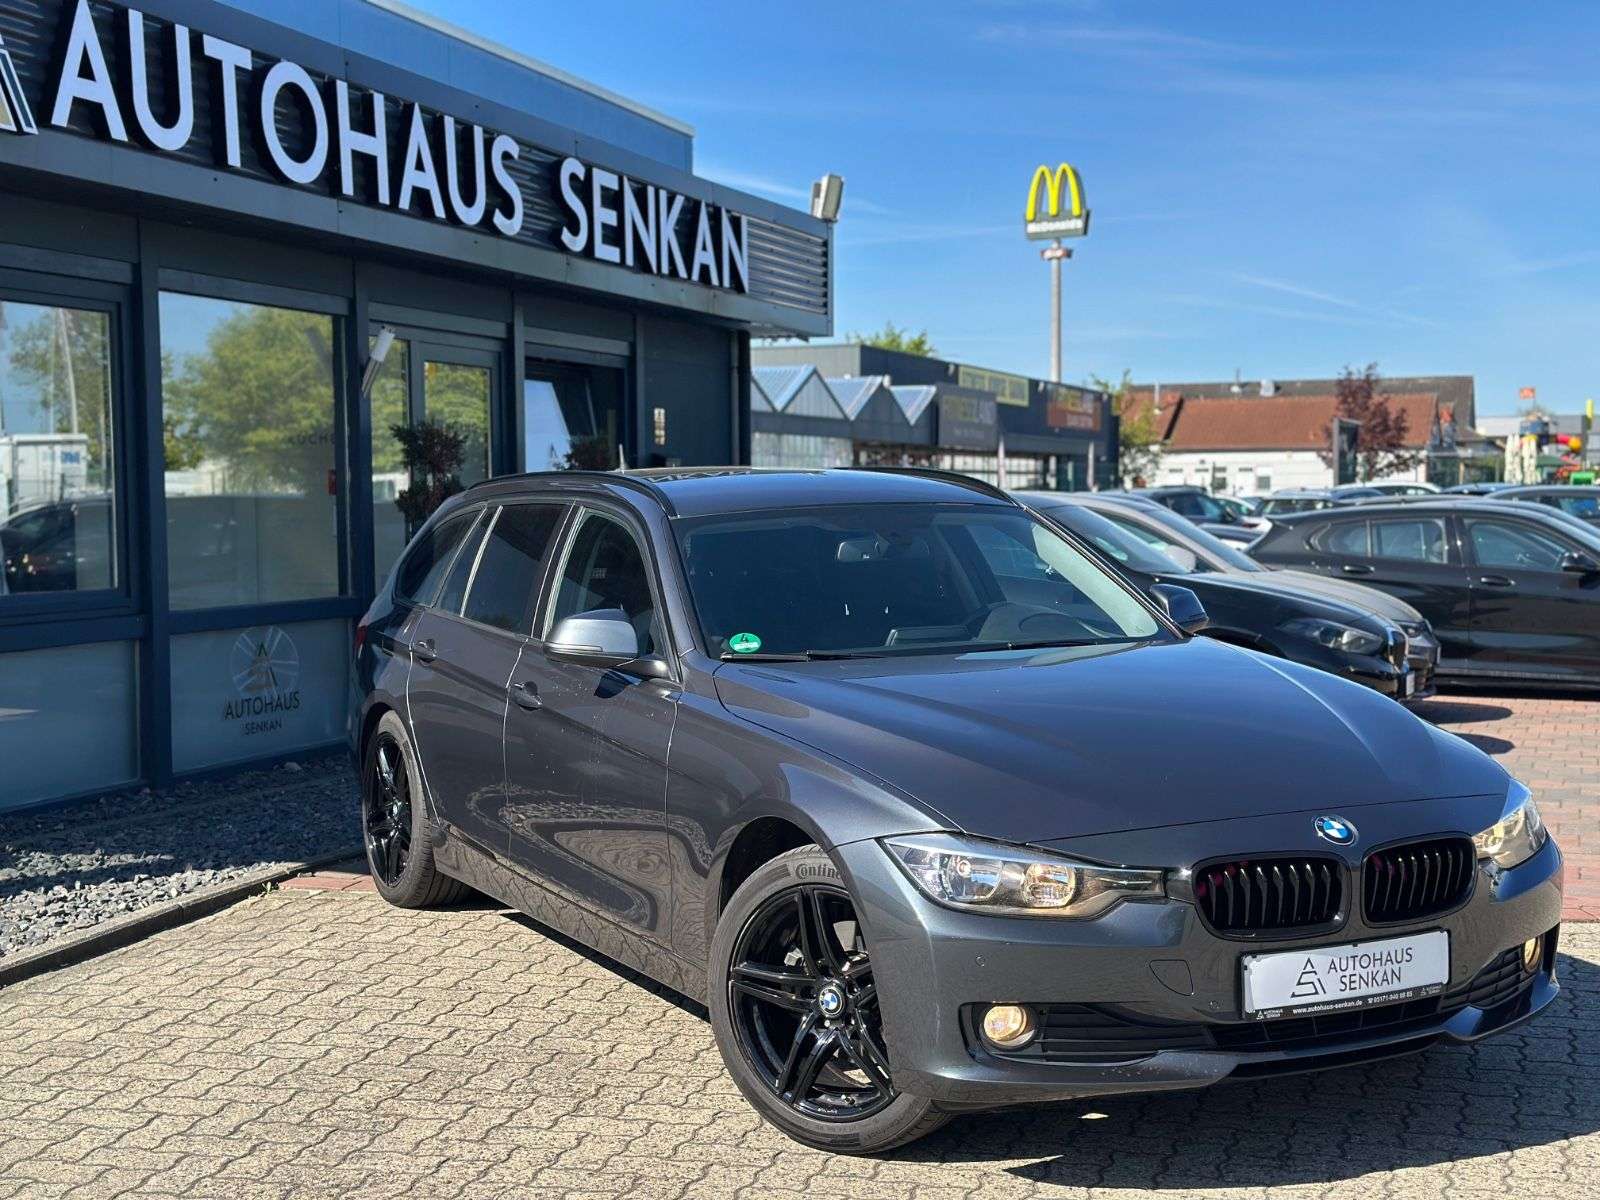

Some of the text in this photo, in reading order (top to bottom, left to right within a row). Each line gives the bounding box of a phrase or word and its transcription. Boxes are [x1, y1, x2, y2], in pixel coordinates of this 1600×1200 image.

[51, 0, 749, 293] AUTOHAUS SENKAN
[224, 691, 300, 720] AUTOHAUS
[244, 720, 282, 735] SENKAN
[1327, 947, 1413, 974] AUTOHAUS
[1339, 968, 1401, 992] SENKAN
